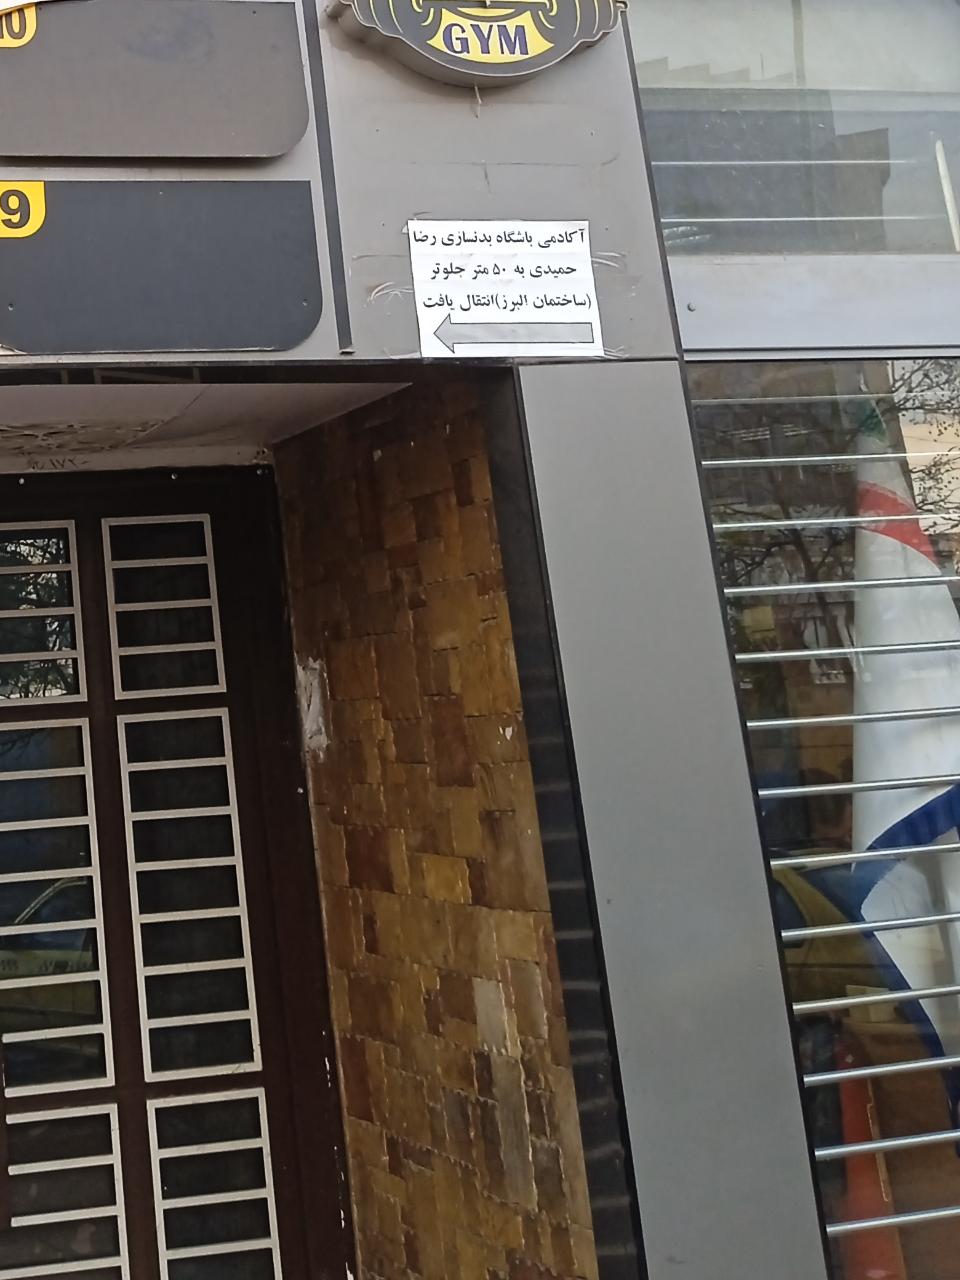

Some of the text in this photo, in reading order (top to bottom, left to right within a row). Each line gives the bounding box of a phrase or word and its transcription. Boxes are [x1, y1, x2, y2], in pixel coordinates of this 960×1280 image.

[442, 23, 530, 56] GYM
[413, 228, 586, 248] آکادمی باشگاه بدنسازی رضا
[430, 262, 578, 281] حمیدی به ۵۰ متر جلوتر
[422, 293, 454, 311] یافت
